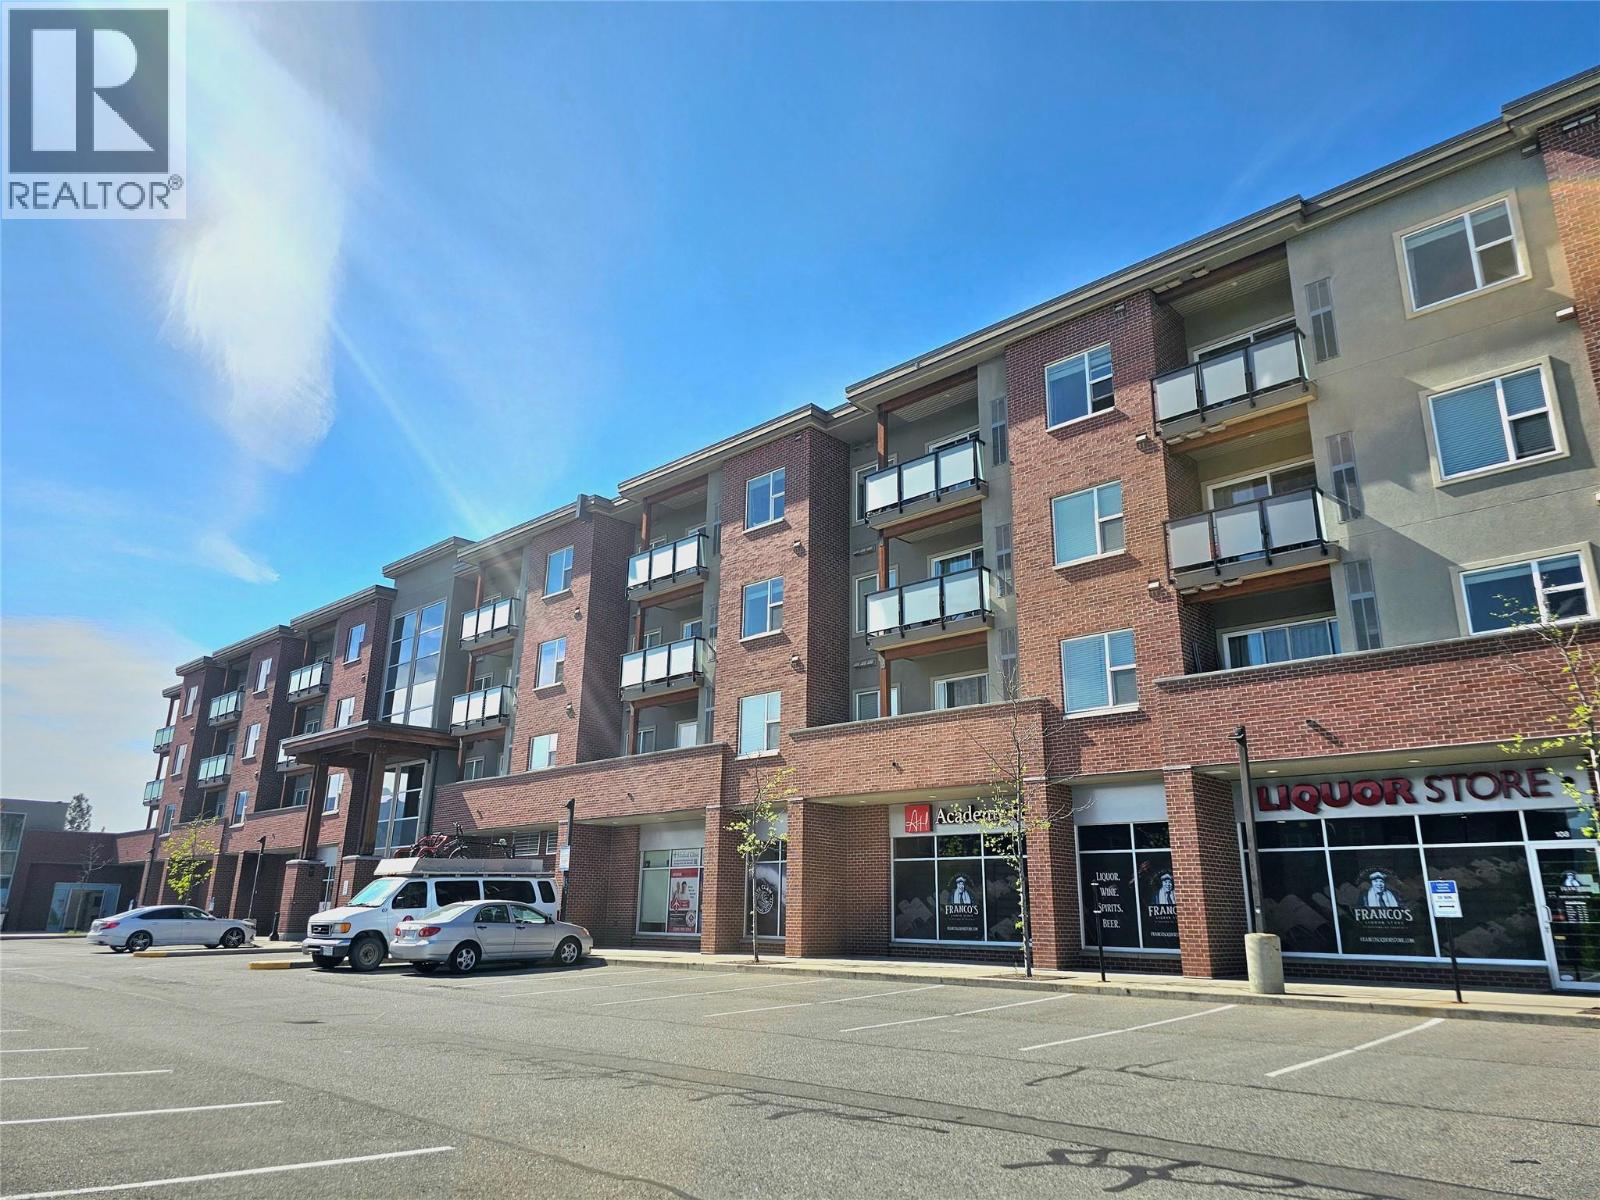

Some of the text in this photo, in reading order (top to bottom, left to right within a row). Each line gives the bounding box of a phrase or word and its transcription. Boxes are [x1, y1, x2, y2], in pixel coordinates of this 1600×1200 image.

[1257, 767, 1553, 815] LIQUOR STORE
[1096, 872, 1120, 882] LIQUOR.
[1100, 887, 1120, 897] WINE.
[945, 905, 979, 915] FRANCO'S
[1099, 902, 1123, 913] SPIRITS.
[1148, 905, 1178, 917] FRANC
[1354, 908, 1413, 921] FRANCO'S
[1102, 918, 1121, 929] BEER.
